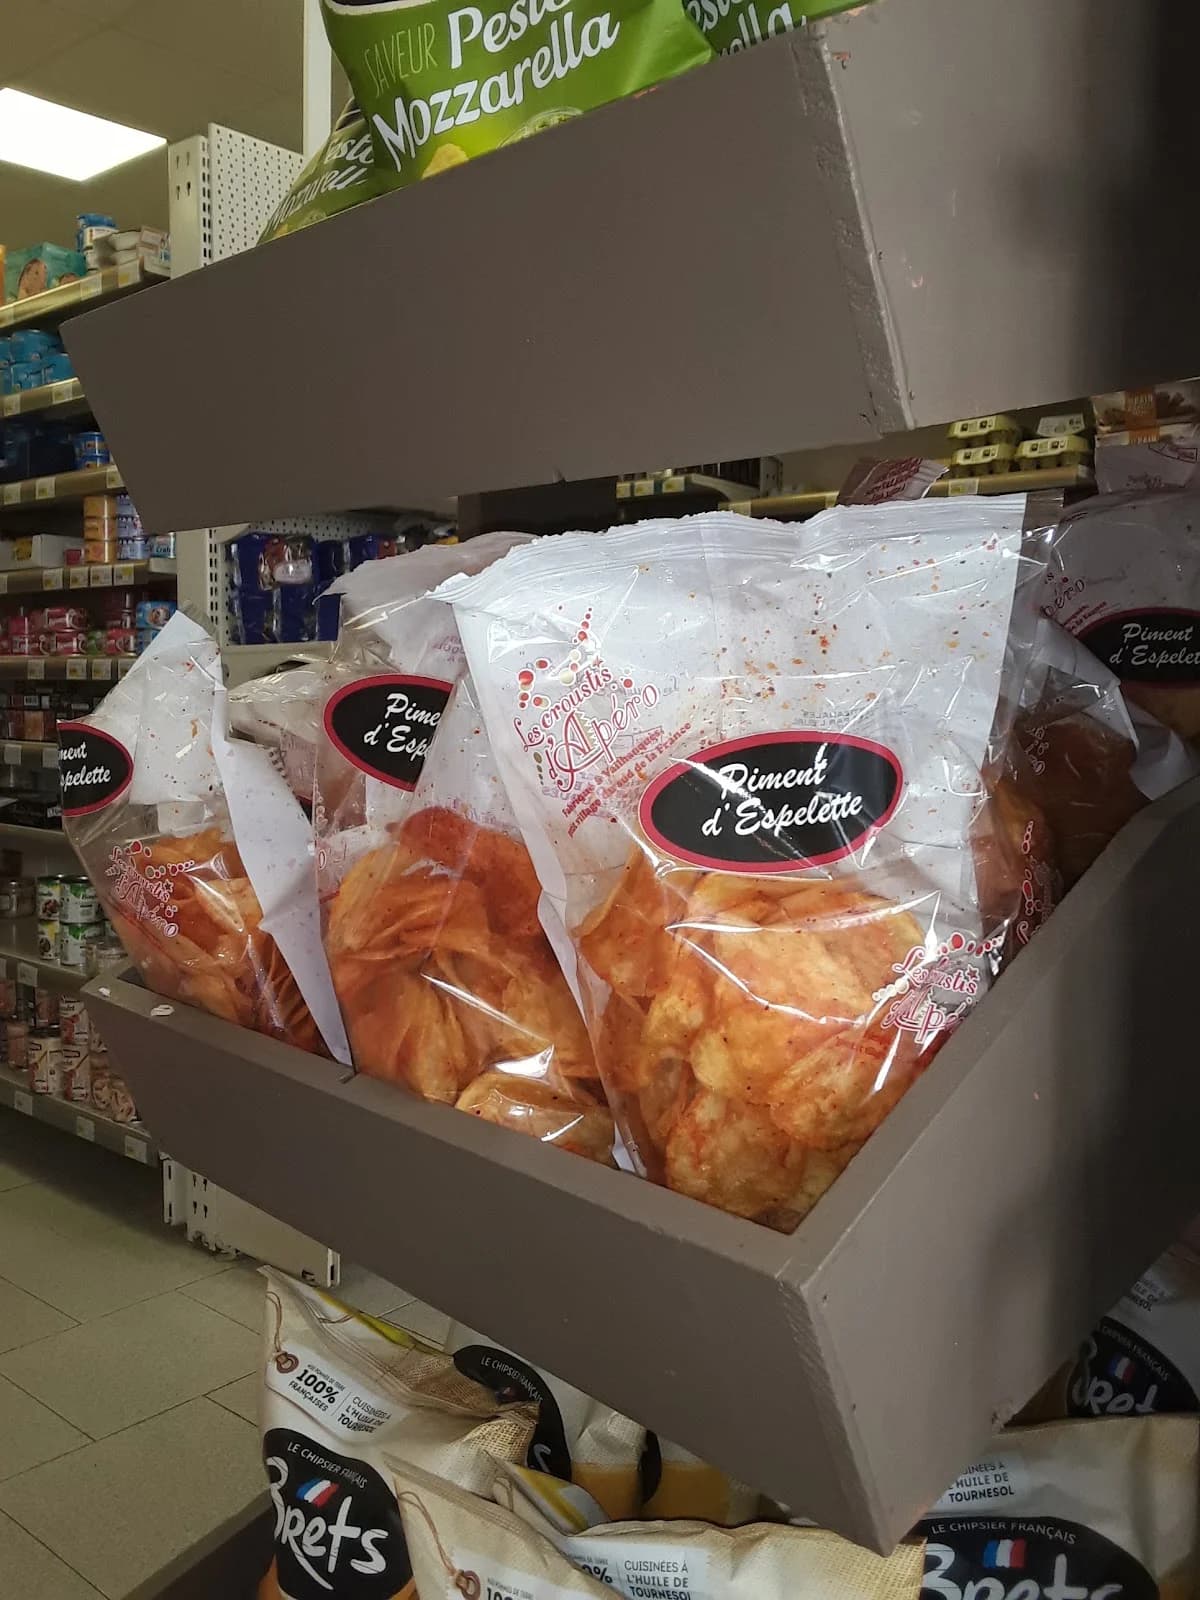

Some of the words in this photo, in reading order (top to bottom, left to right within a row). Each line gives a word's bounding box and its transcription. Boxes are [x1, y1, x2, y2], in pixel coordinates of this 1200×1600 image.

[364, 22, 438, 97] SAVEUR
[448, 0, 571, 70] Pest
[372, 10, 621, 173] Mozzarella
[1121, 622, 1193, 643] Piment
[514, 717, 545, 752] Les
[541, 667, 612, 730] croustis
[545, 683, 658, 793] d'Apéro
[616, 769, 634, 788] sud
[634, 761, 647, 772] de
[644, 752, 658, 763] la
[655, 722, 692, 754] France
[719, 756, 828, 800] Piment
[702, 791, 863, 837] d'Espelette
[481, 1356, 490, 1367] LE
[288, 1380, 329, 1412] FRANÇAISES
[296, 1369, 340, 1404] 100%
[287, 1441, 301, 1454] LE
[300, 1448, 342, 1476] CHIPSIER
[948, 1485, 1015, 1503] TOURNESOL
[994, 1471, 1009, 1484] DE
[931, 1524, 946, 1535] LE
[949, 1520, 1006, 1533] CHIPSIER
[1011, 1522, 1078, 1545] FRANÇAIS
[624, 1559, 679, 1573] CUISINÉES
[626, 1574, 669, 1587] L'HUILE
[673, 1577, 689, 1588] DE
